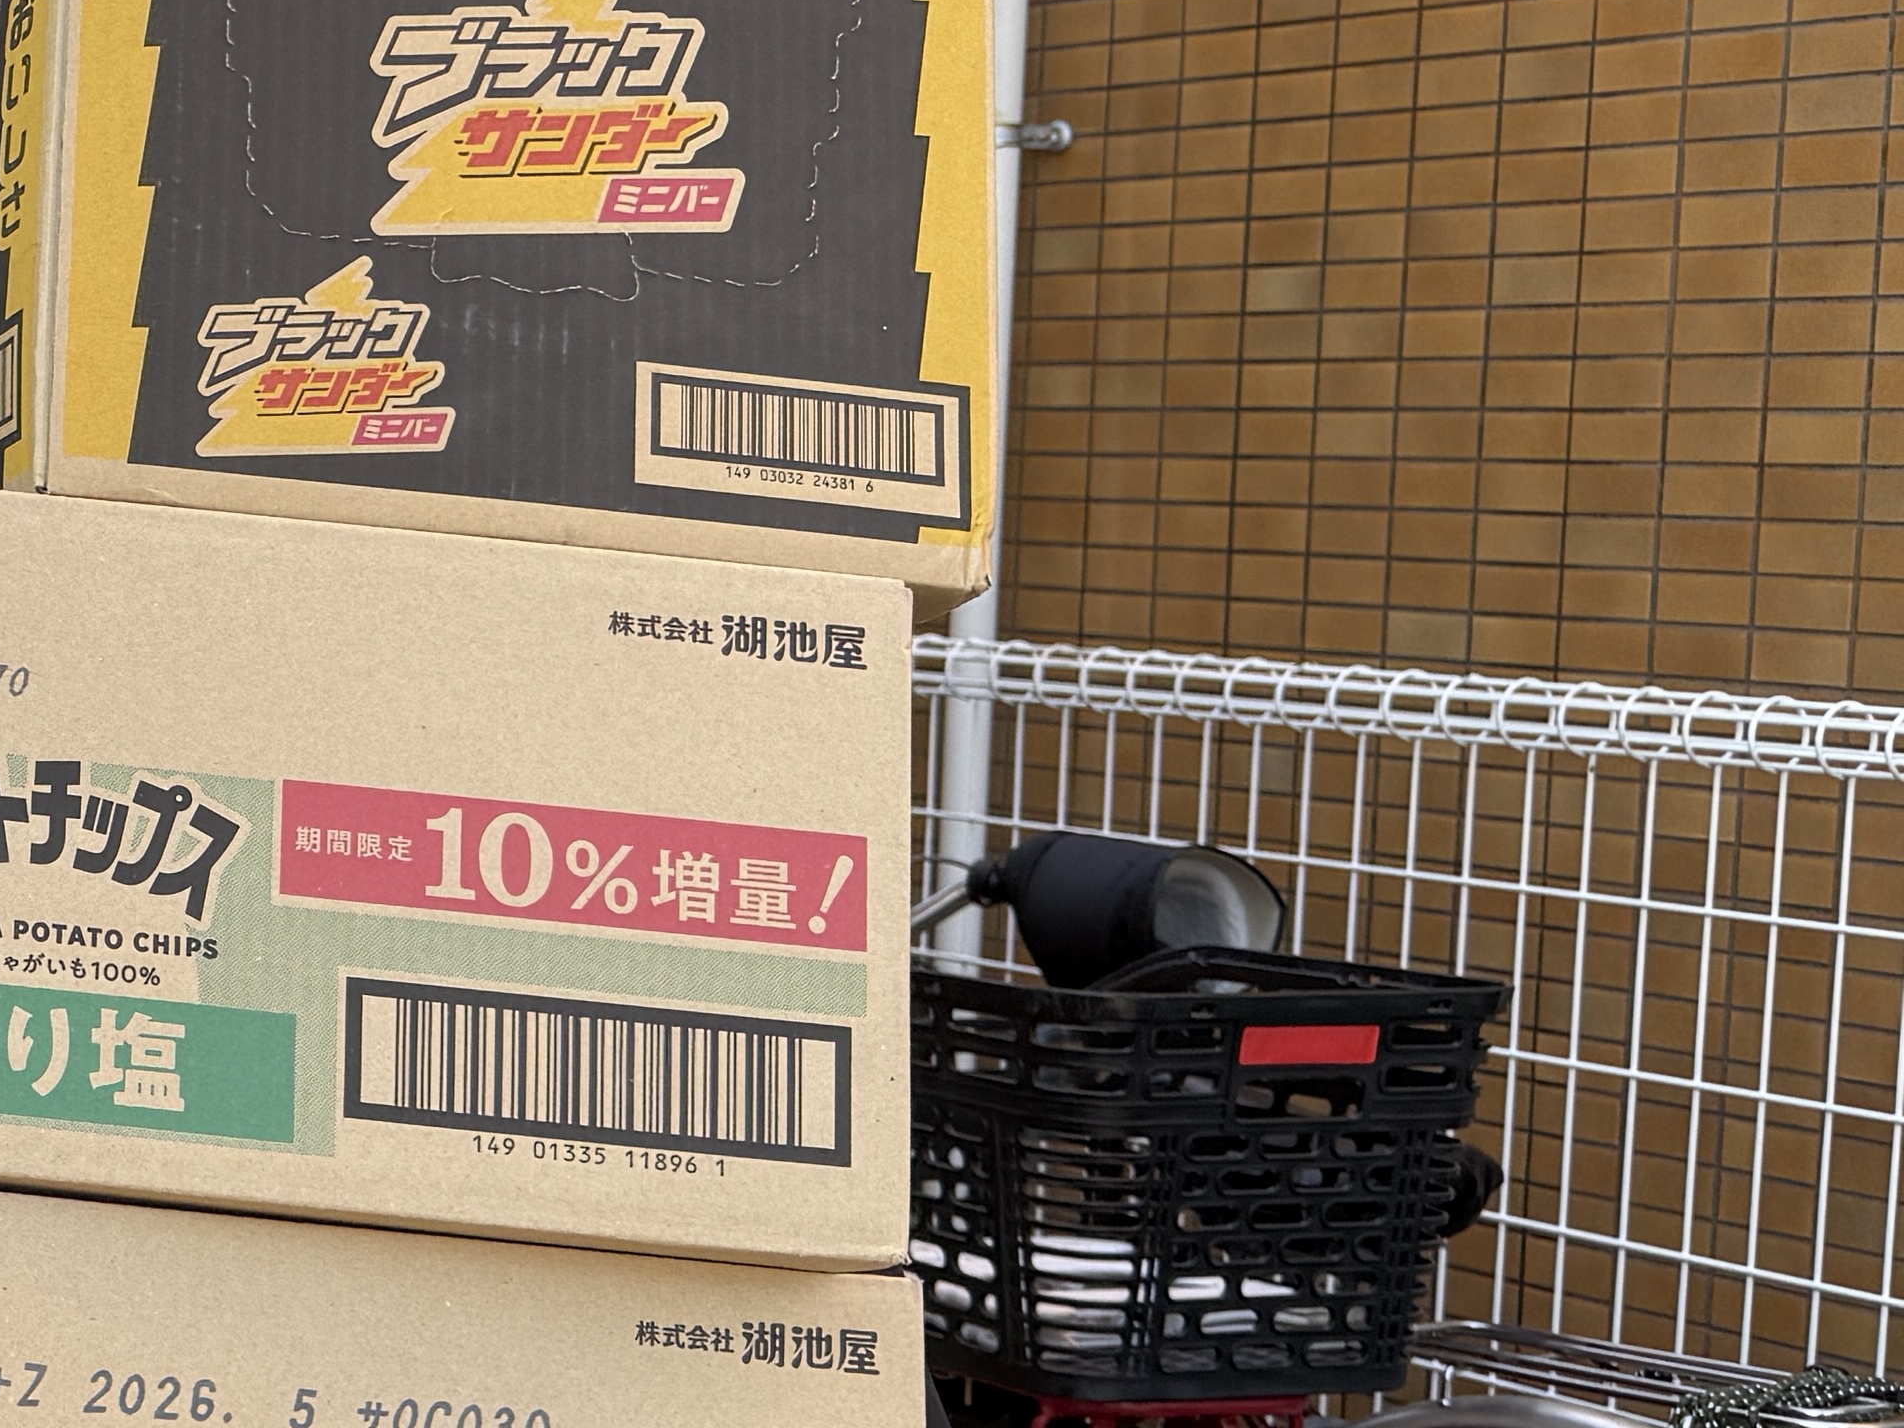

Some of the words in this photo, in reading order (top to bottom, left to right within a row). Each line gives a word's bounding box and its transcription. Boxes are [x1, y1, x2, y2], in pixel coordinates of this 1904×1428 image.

[381, 15, 696, 136] ブラック
[456, 102, 718, 178] サンダー
[613, 183, 720, 214] ミニバー
[205, 305, 423, 388] ブラック
[255, 362, 438, 416] サンダー
[362, 418, 437, 440] ミニバー
[726, 465, 751, 480] 149
[759, 469, 804, 486] 03032
[813, 474, 855, 492] 24381
[865, 480, 874, 494] 6
[294, 825, 414, 864] 期間限定
[12, 918, 124, 951] POTATO
[134, 932, 220, 961] CHIPS
[472, 1134, 516, 1157] 149
[532, 1139, 607, 1166] 01335
[624, 1149, 698, 1175] 11896
[716, 1158, 726, 1177] 1
[82, 1369, 234, 1425] 2026.
